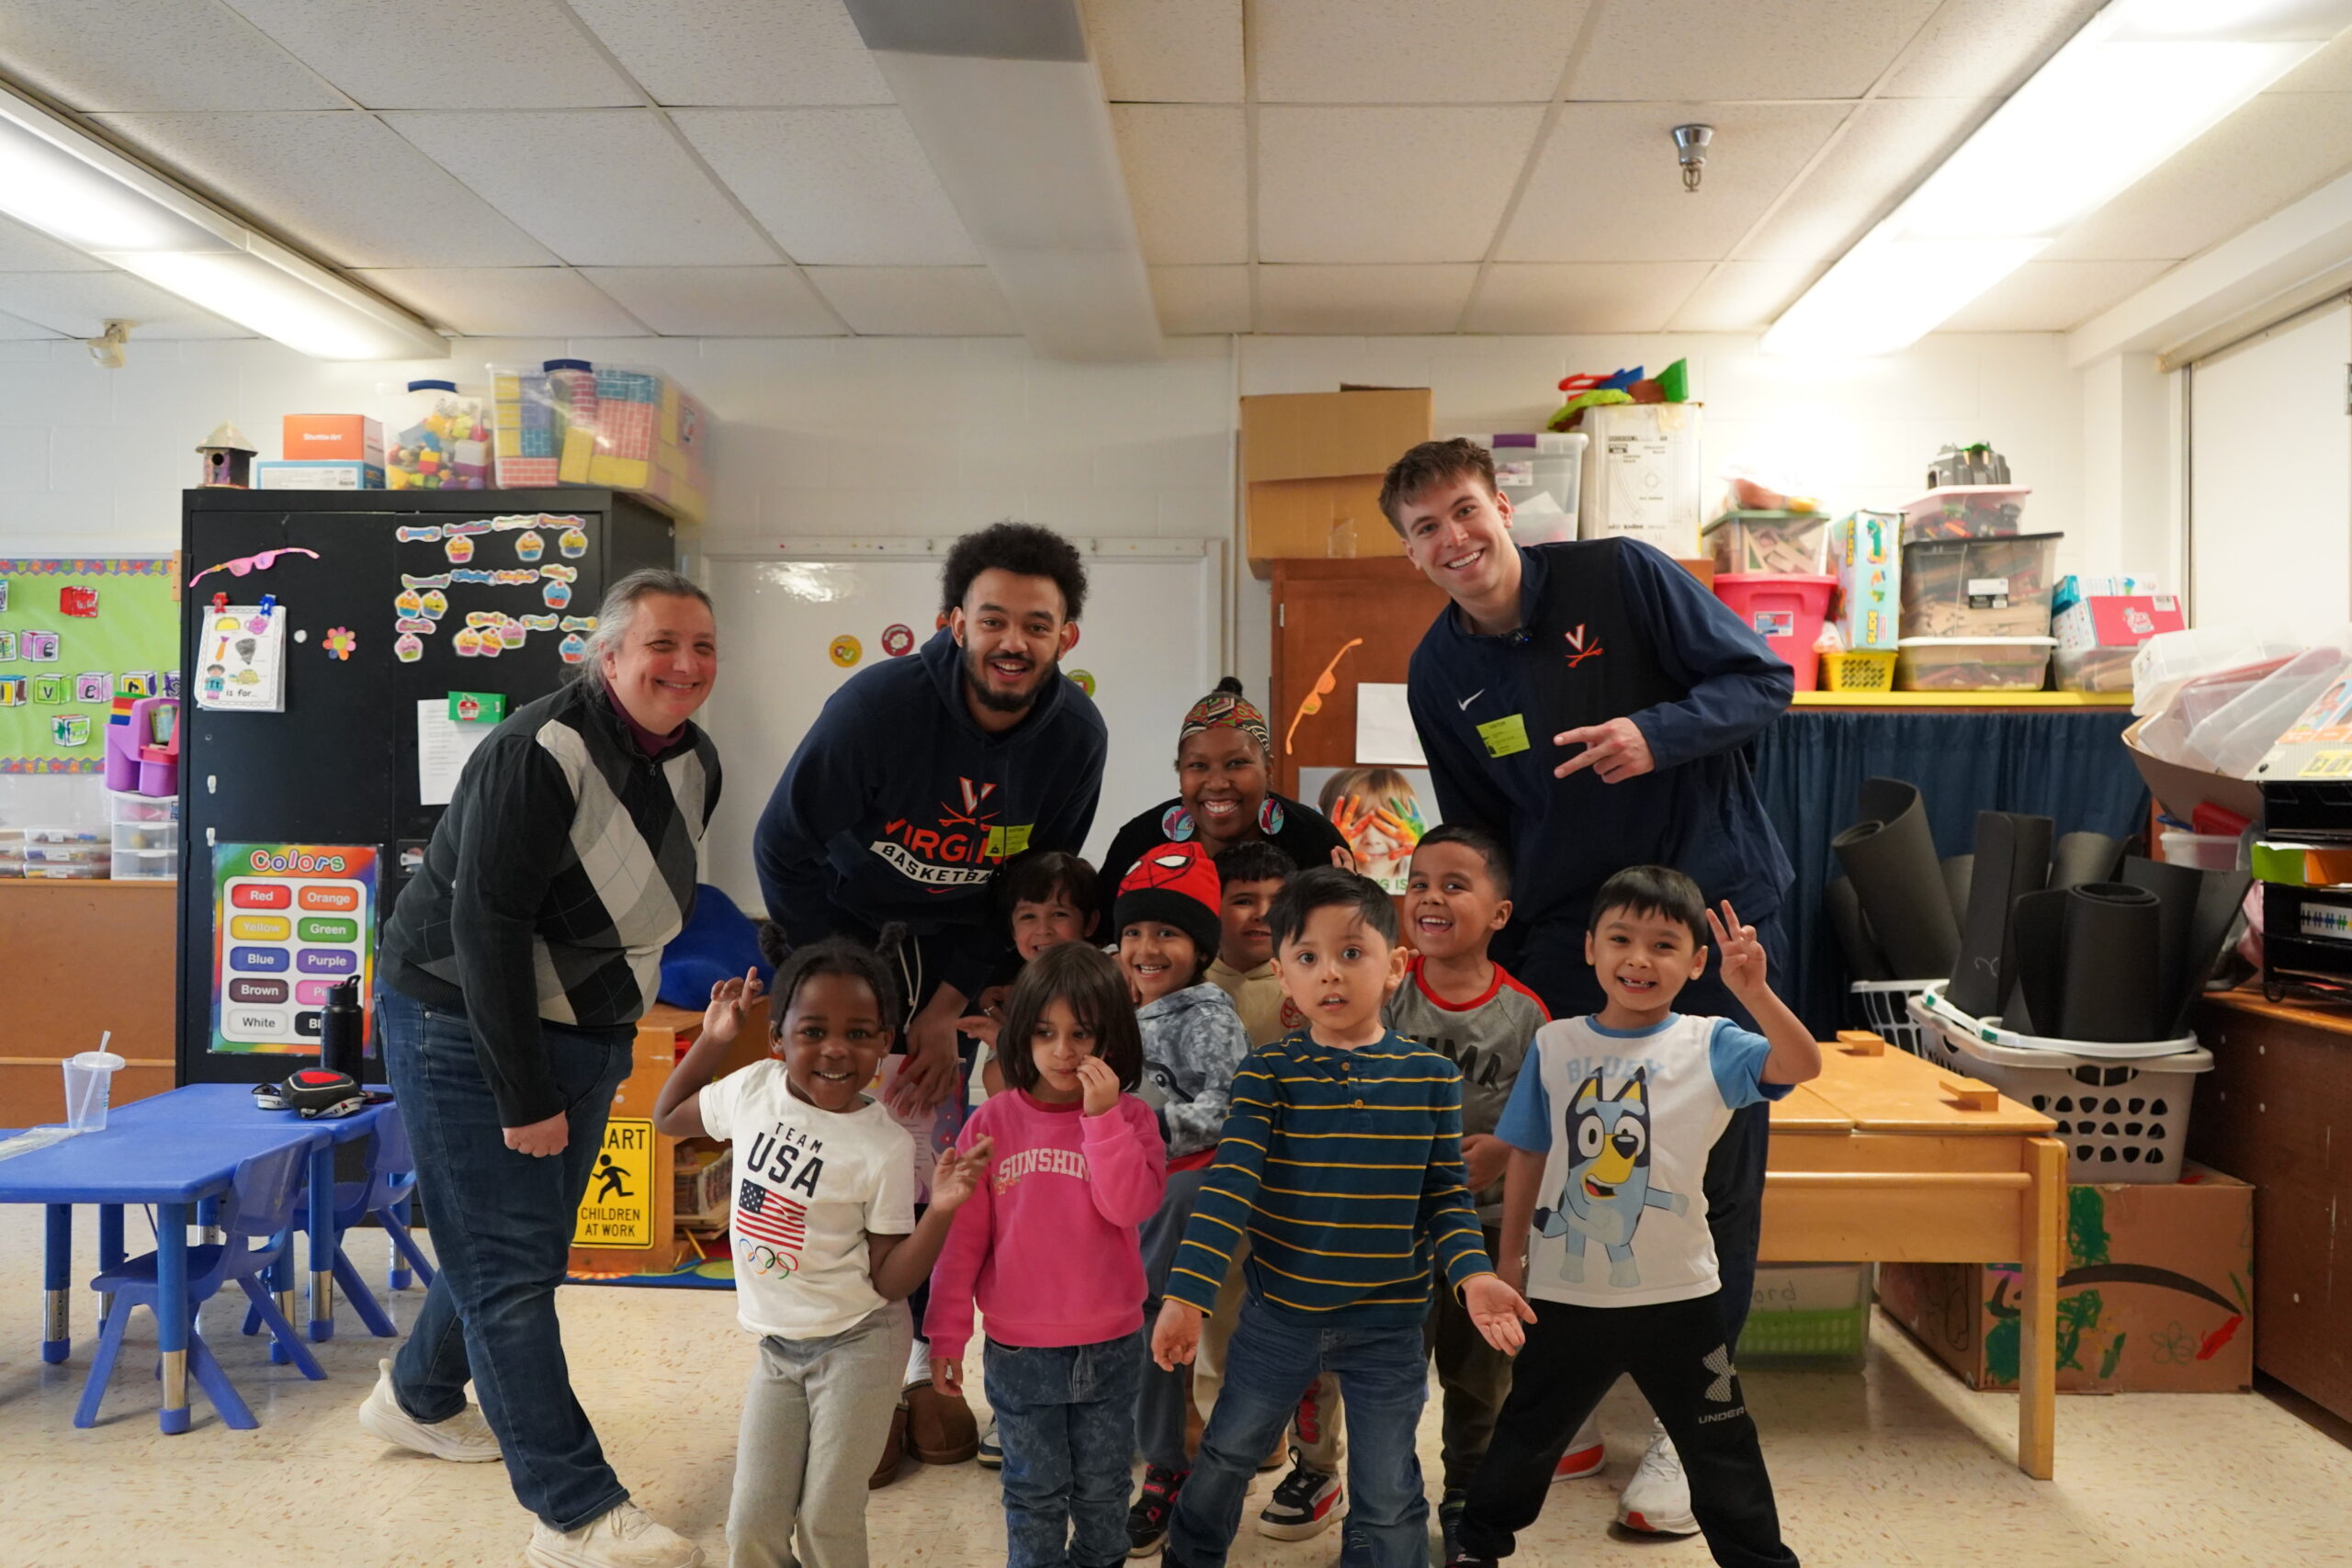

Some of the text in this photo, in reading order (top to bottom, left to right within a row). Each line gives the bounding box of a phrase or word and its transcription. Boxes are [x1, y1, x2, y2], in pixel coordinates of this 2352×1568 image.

[250, 849, 346, 872] Colors
[250, 890, 351, 906] Red Orange
[243, 921, 346, 935] Yellow Green
[247, 953, 347, 968] Blue Purple
[241, 985, 328, 998] Brown Pi
[243, 1016, 276, 1028] White
[602, 1129, 646, 1150] ART
[775, 1122, 823, 1155] TEAM
[747, 1132, 824, 1198] USA
[999, 1148, 1091, 1184] SUNSHIN
[581, 1207, 640, 1221] CHILDREN
[584, 1224, 635, 1237] AT WORK
[1754, 1280, 1797, 1303] ord
[1698, 1405, 1745, 1425] UNDER
